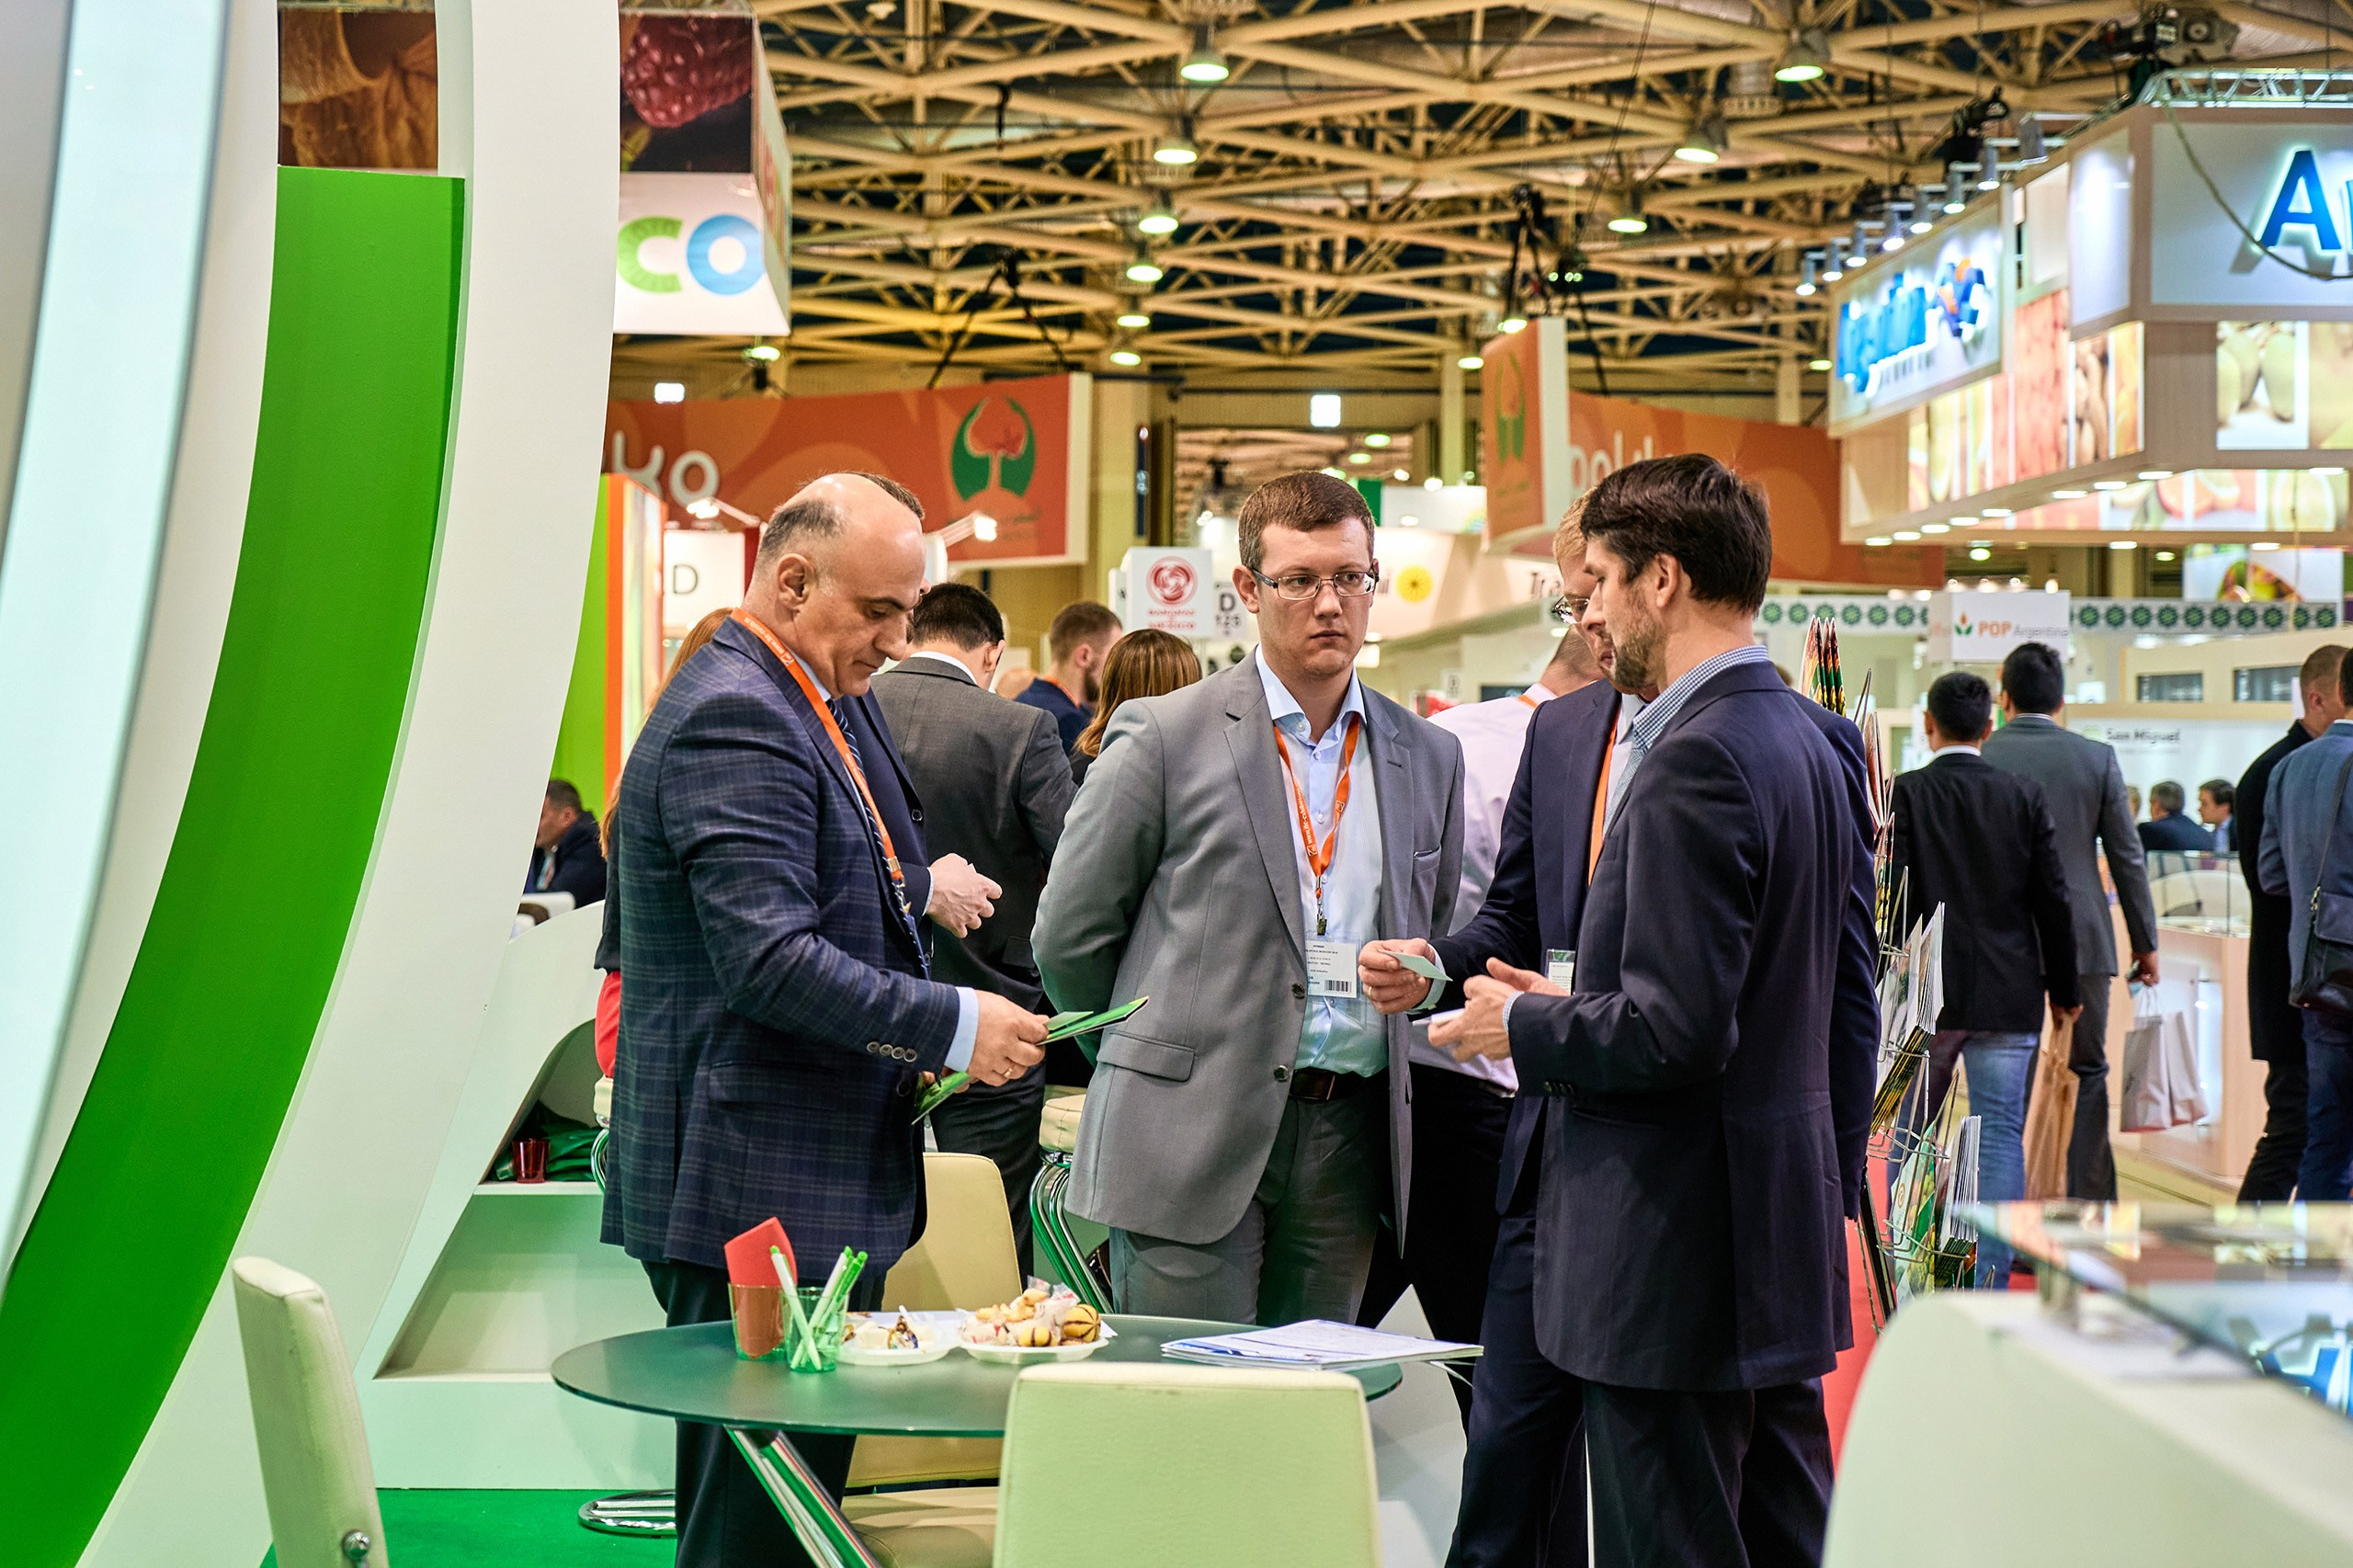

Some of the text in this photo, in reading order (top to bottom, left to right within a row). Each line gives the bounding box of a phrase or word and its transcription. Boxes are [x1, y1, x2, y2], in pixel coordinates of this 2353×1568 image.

[2259, 150, 2353, 251] A
[672, 563, 699, 595] D
[1219, 592, 1236, 613] D
[1978, 619, 2012, 638] POP
